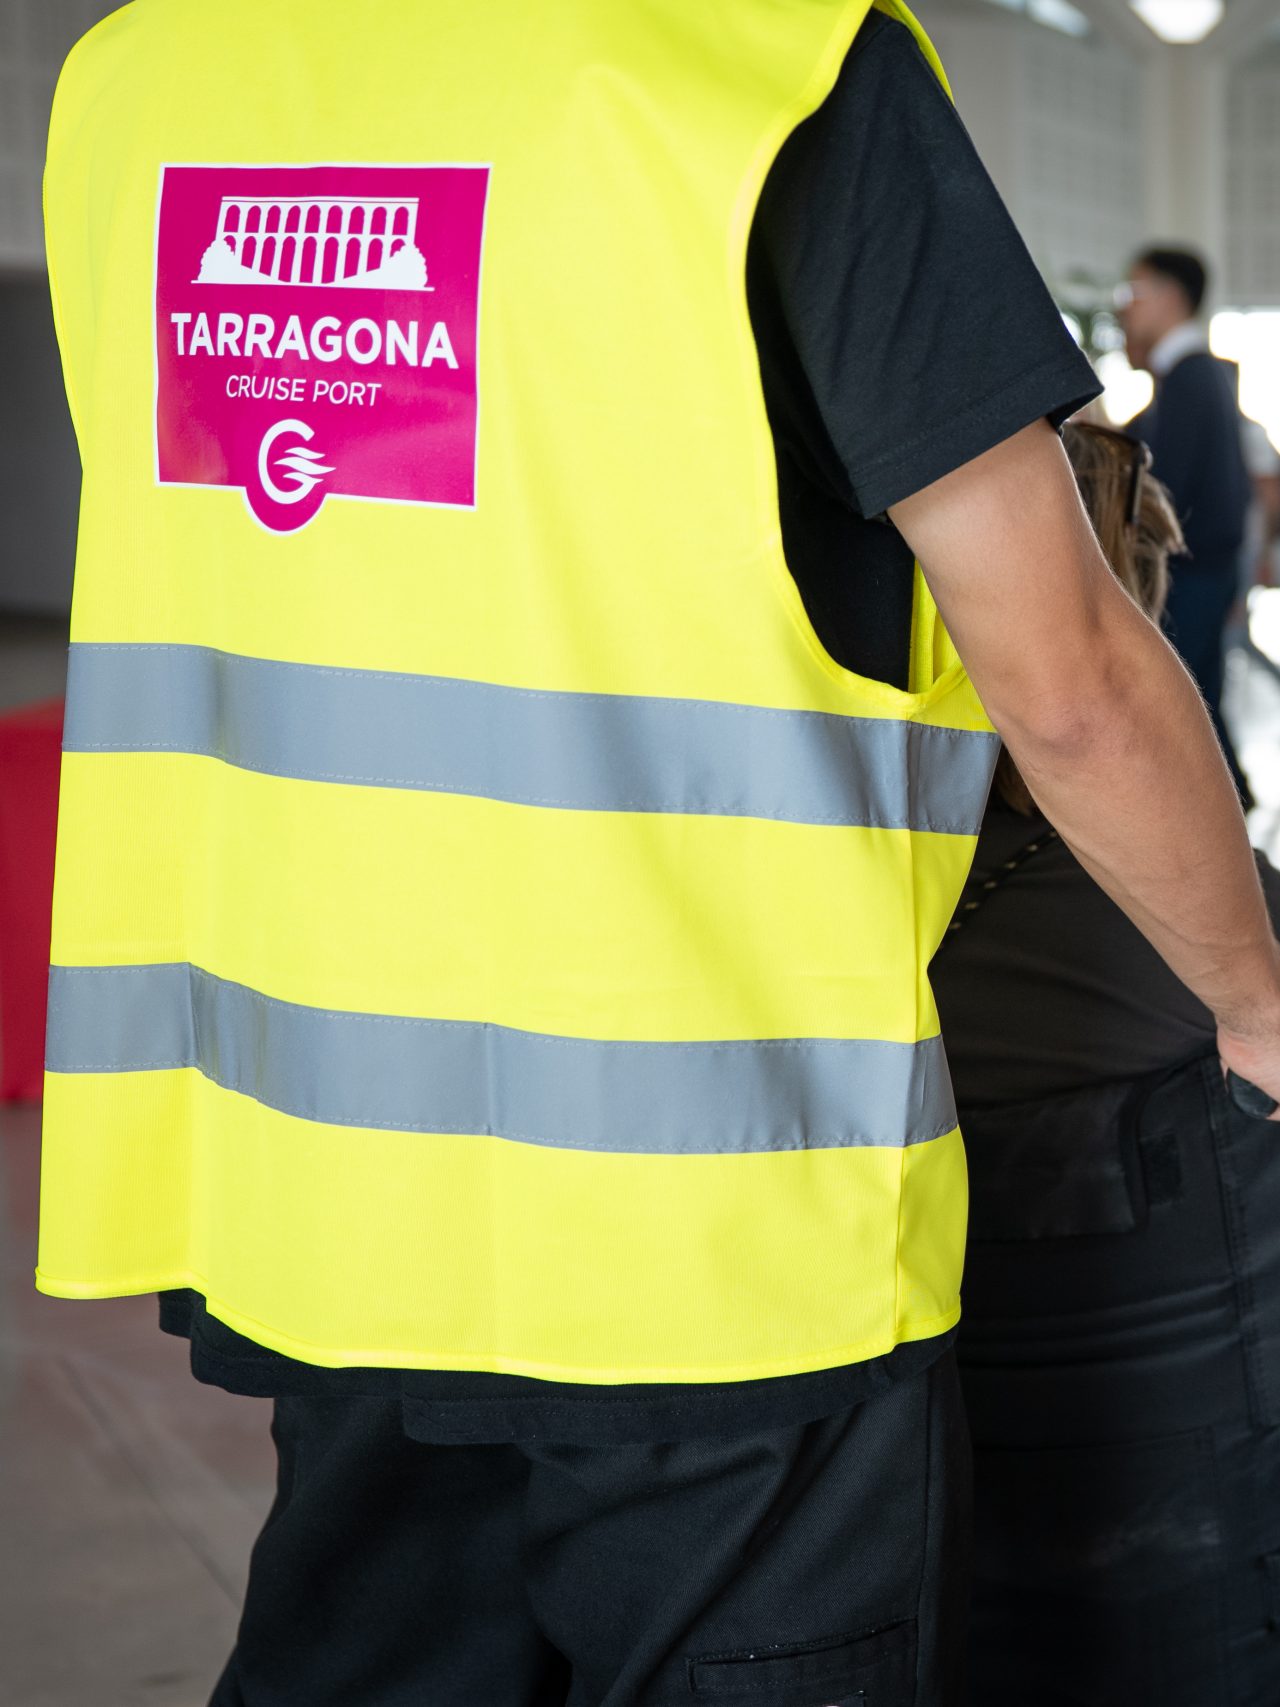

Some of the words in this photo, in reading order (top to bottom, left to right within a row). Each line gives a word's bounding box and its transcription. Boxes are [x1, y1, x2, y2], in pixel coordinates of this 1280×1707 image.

[170, 312, 460, 369] TARRAGONA
[225, 375, 307, 402] CRUISE
[312, 380, 383, 406] PORT
